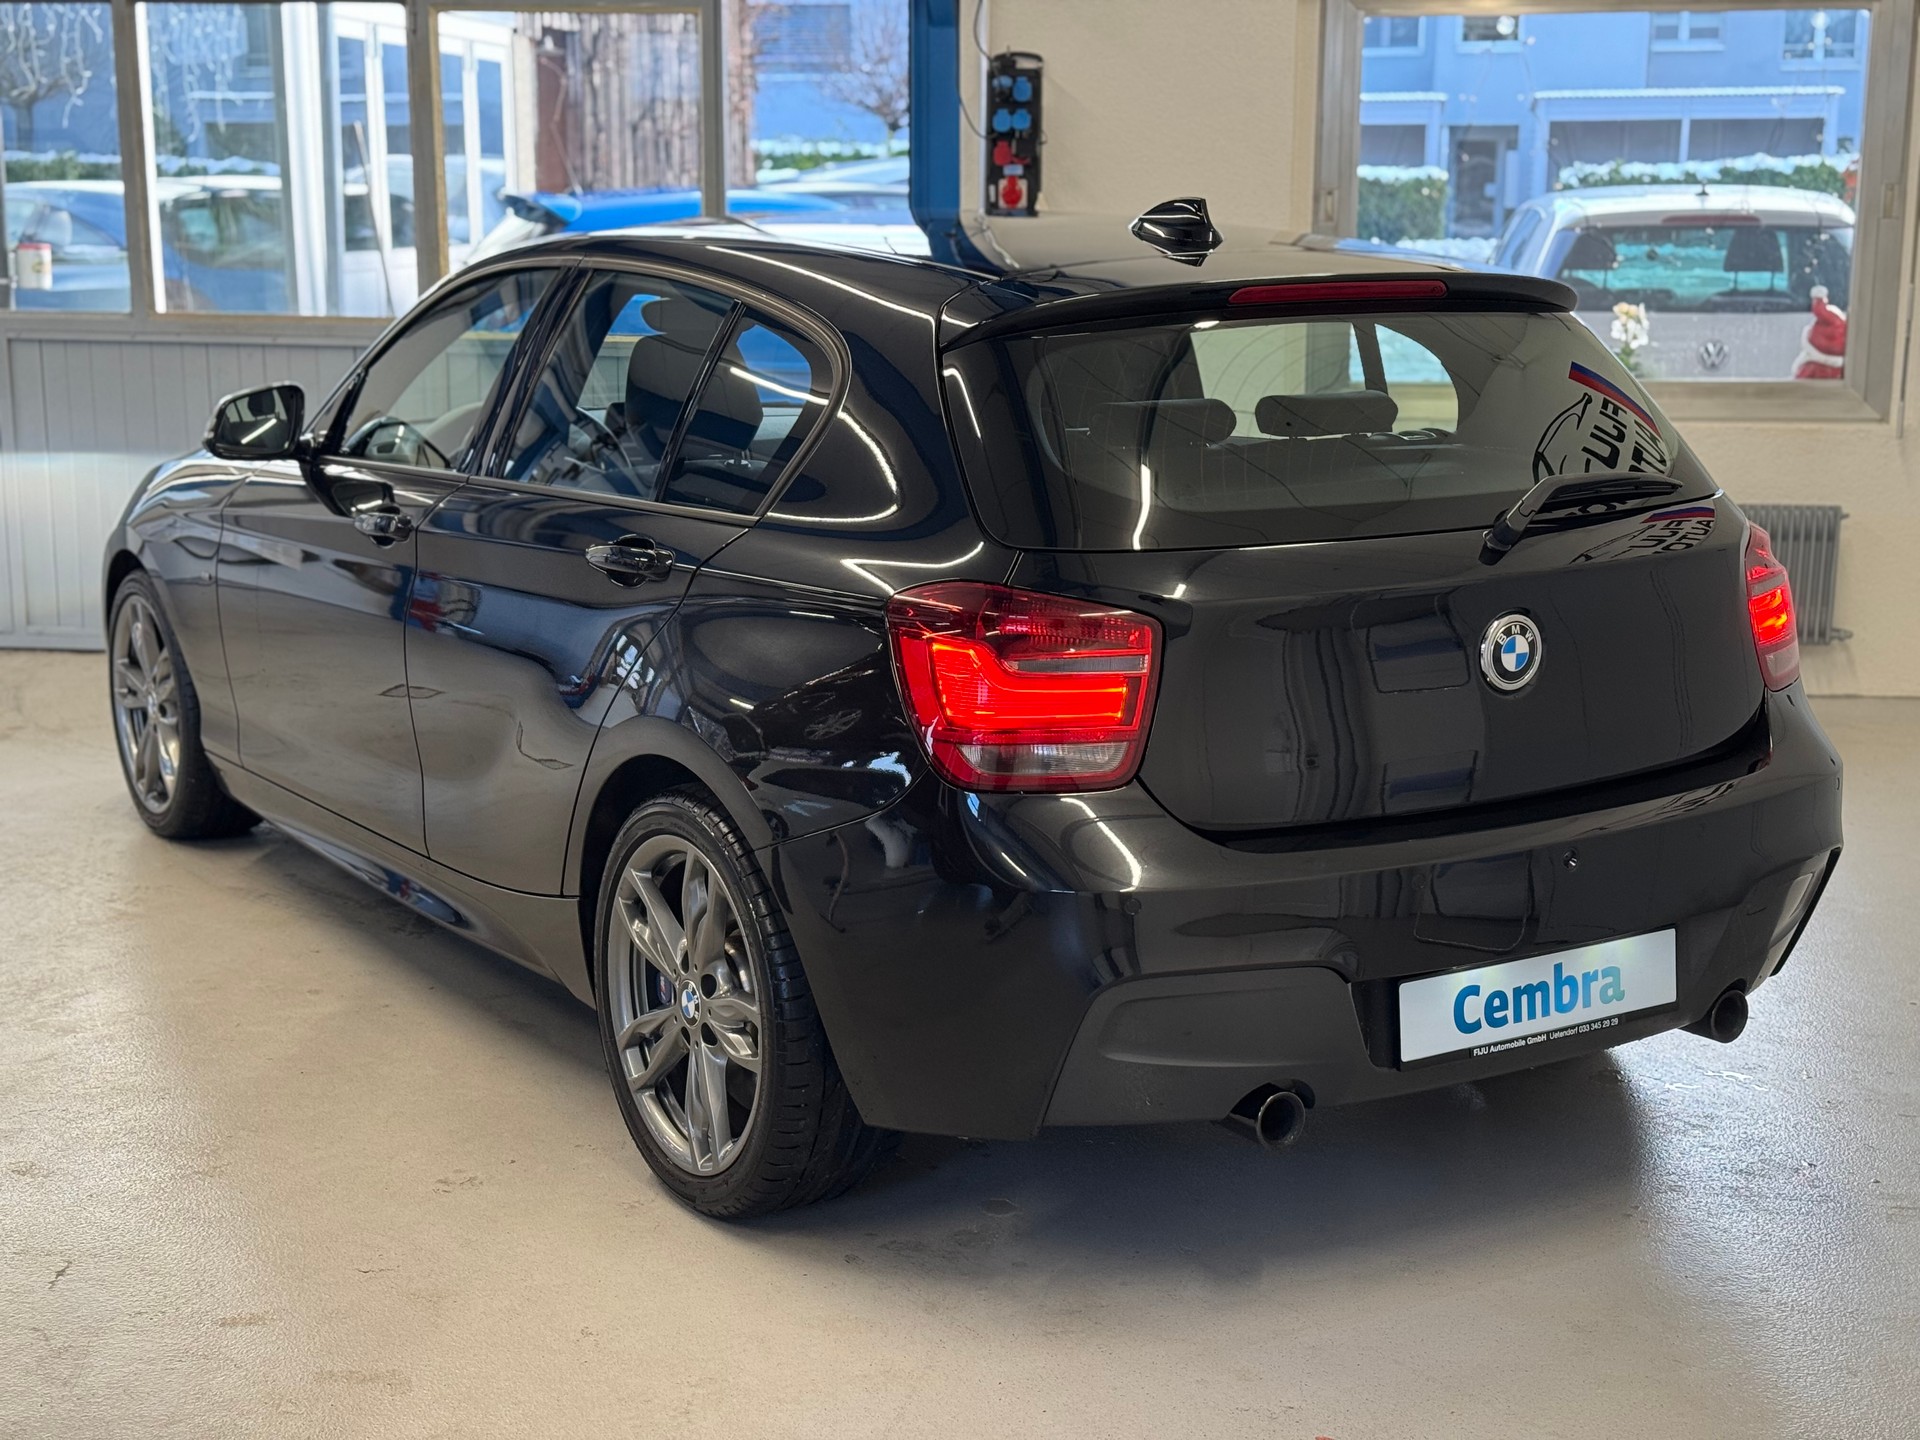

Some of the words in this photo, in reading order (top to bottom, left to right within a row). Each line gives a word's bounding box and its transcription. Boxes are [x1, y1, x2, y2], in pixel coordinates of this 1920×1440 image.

[1497, 625, 1534, 645] BMW
[1453, 962, 1626, 1034] Cembra
[1473, 1047, 1489, 1057] FIJU
[1489, 1039, 1527, 1054] Automobile
[1526, 1034, 1547, 1045] GmbH
[1578, 1024, 1590, 1033] 033
[1590, 1022, 1602, 1031] 345
[1602, 1019, 1610, 1028] 29
[1610, 1017, 1619, 1026] 29
